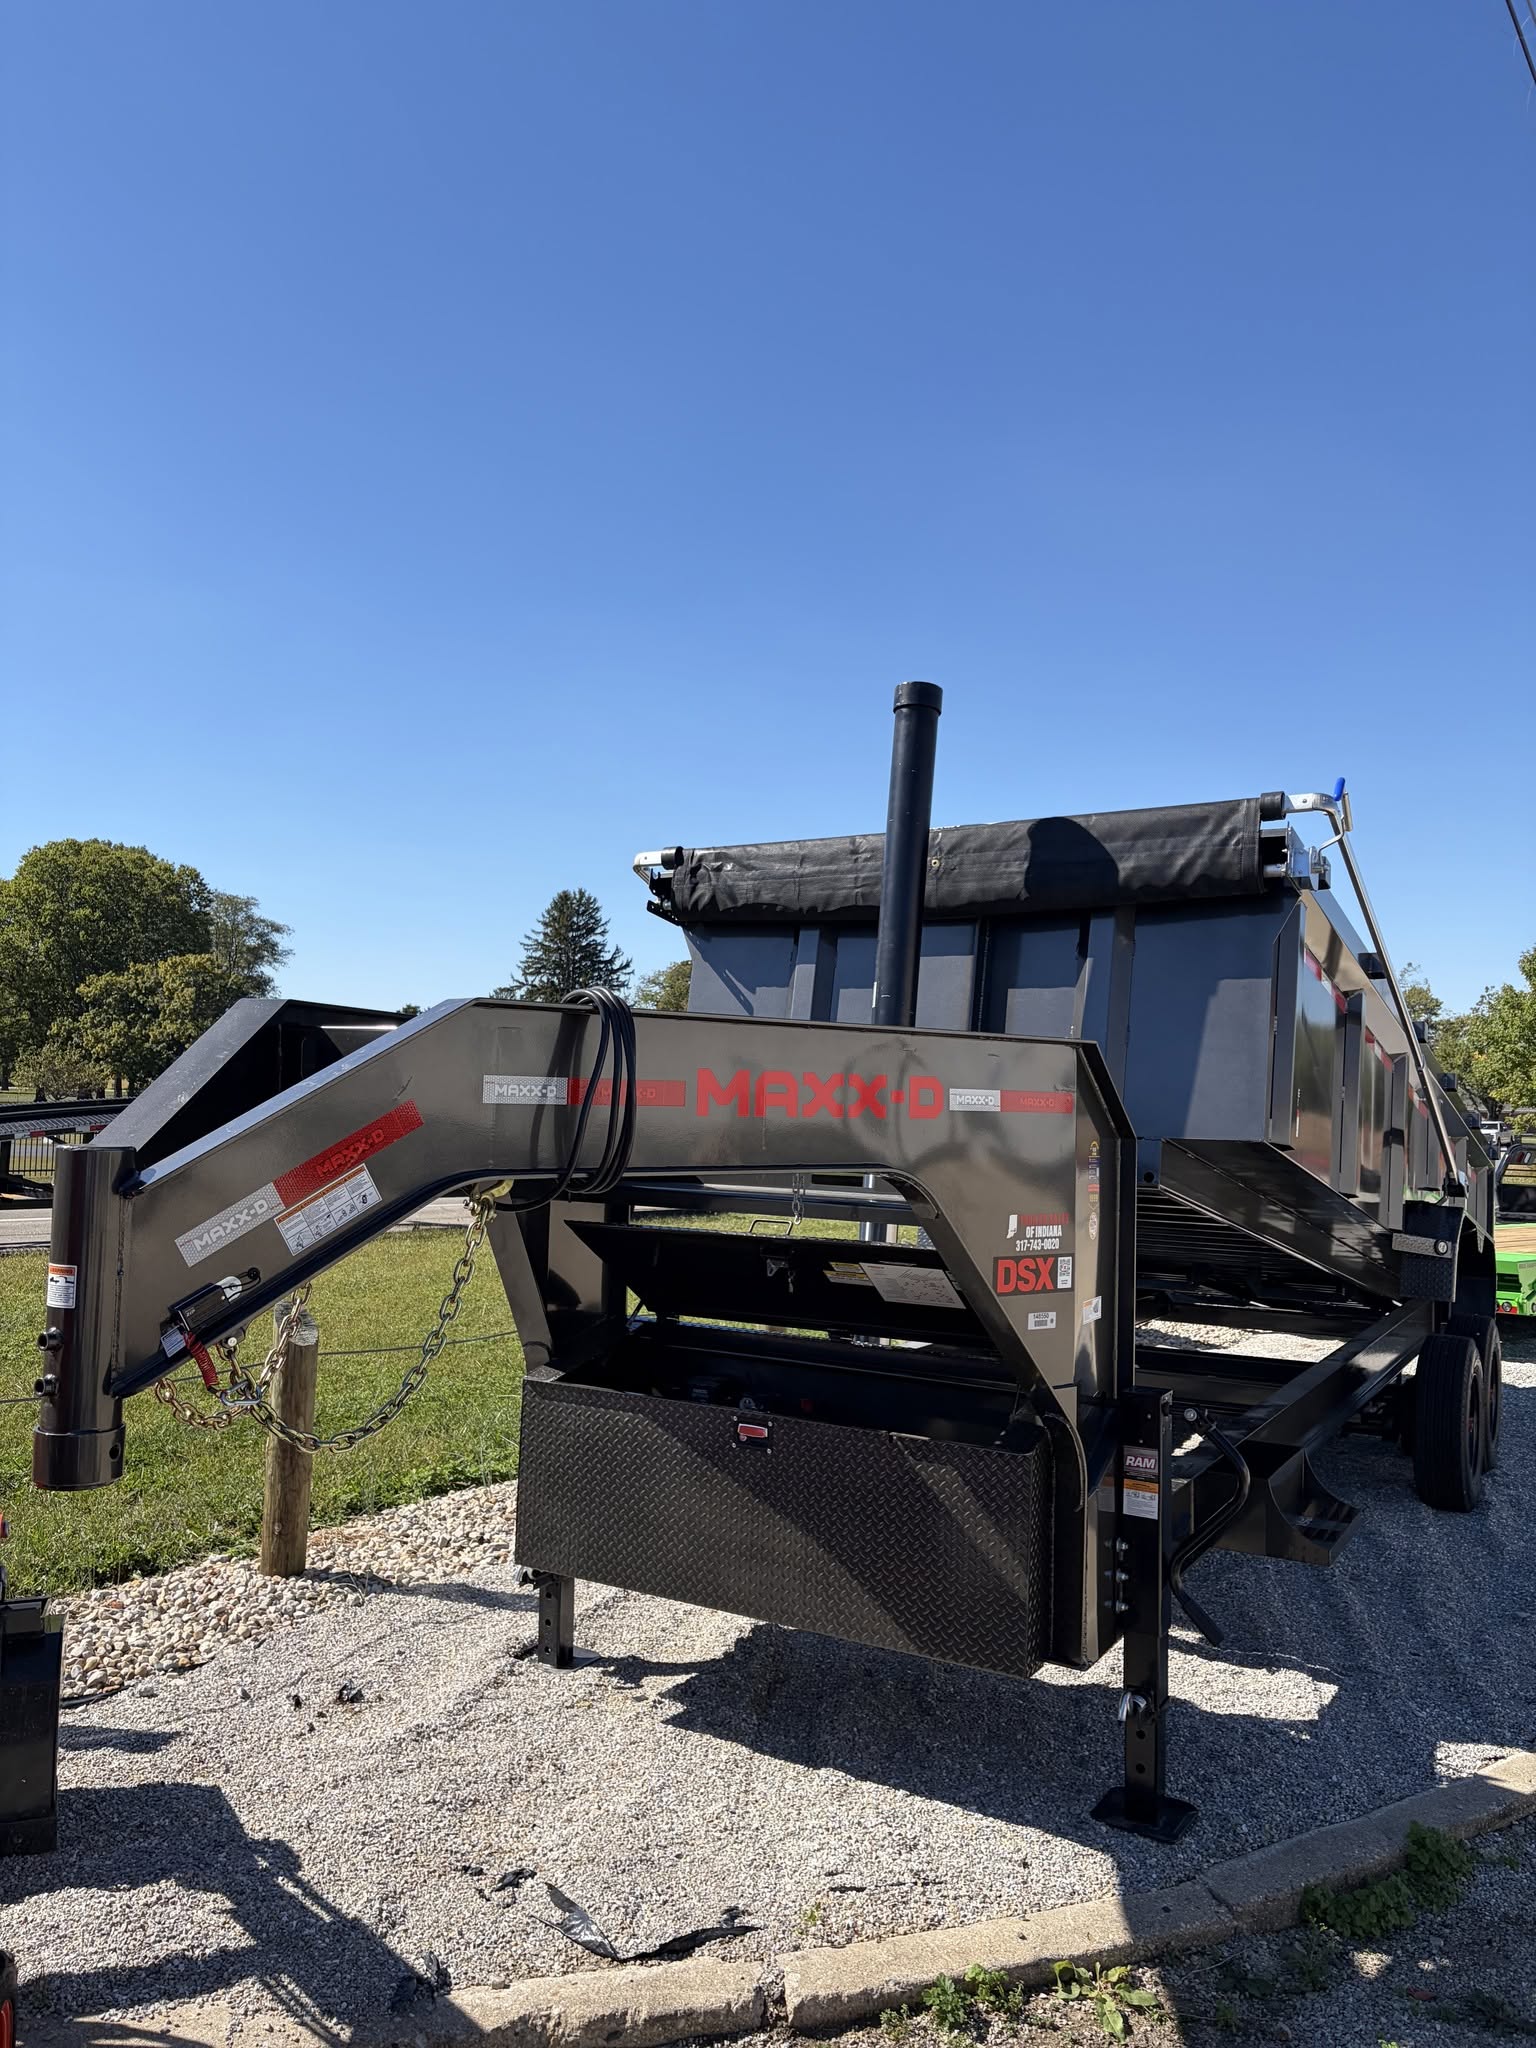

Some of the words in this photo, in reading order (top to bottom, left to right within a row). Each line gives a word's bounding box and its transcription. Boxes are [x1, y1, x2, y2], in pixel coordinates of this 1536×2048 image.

[494, 1084, 557, 1097] MAXX-D
[697, 1068, 944, 1119] MAXX-D
[956, 1095, 995, 1106] MAXX-D
[315, 1129, 385, 1177] MAXX-D
[192, 1199, 269, 1251] MAXX-D
[1025, 1226, 1035, 1238] OF
[1035, 1225, 1062, 1238] INDIANA
[1015, 1238, 1060, 1252] 317-743-0020
[997, 1257, 1055, 1293] DSX
[1125, 1455, 1156, 1469] RAM
